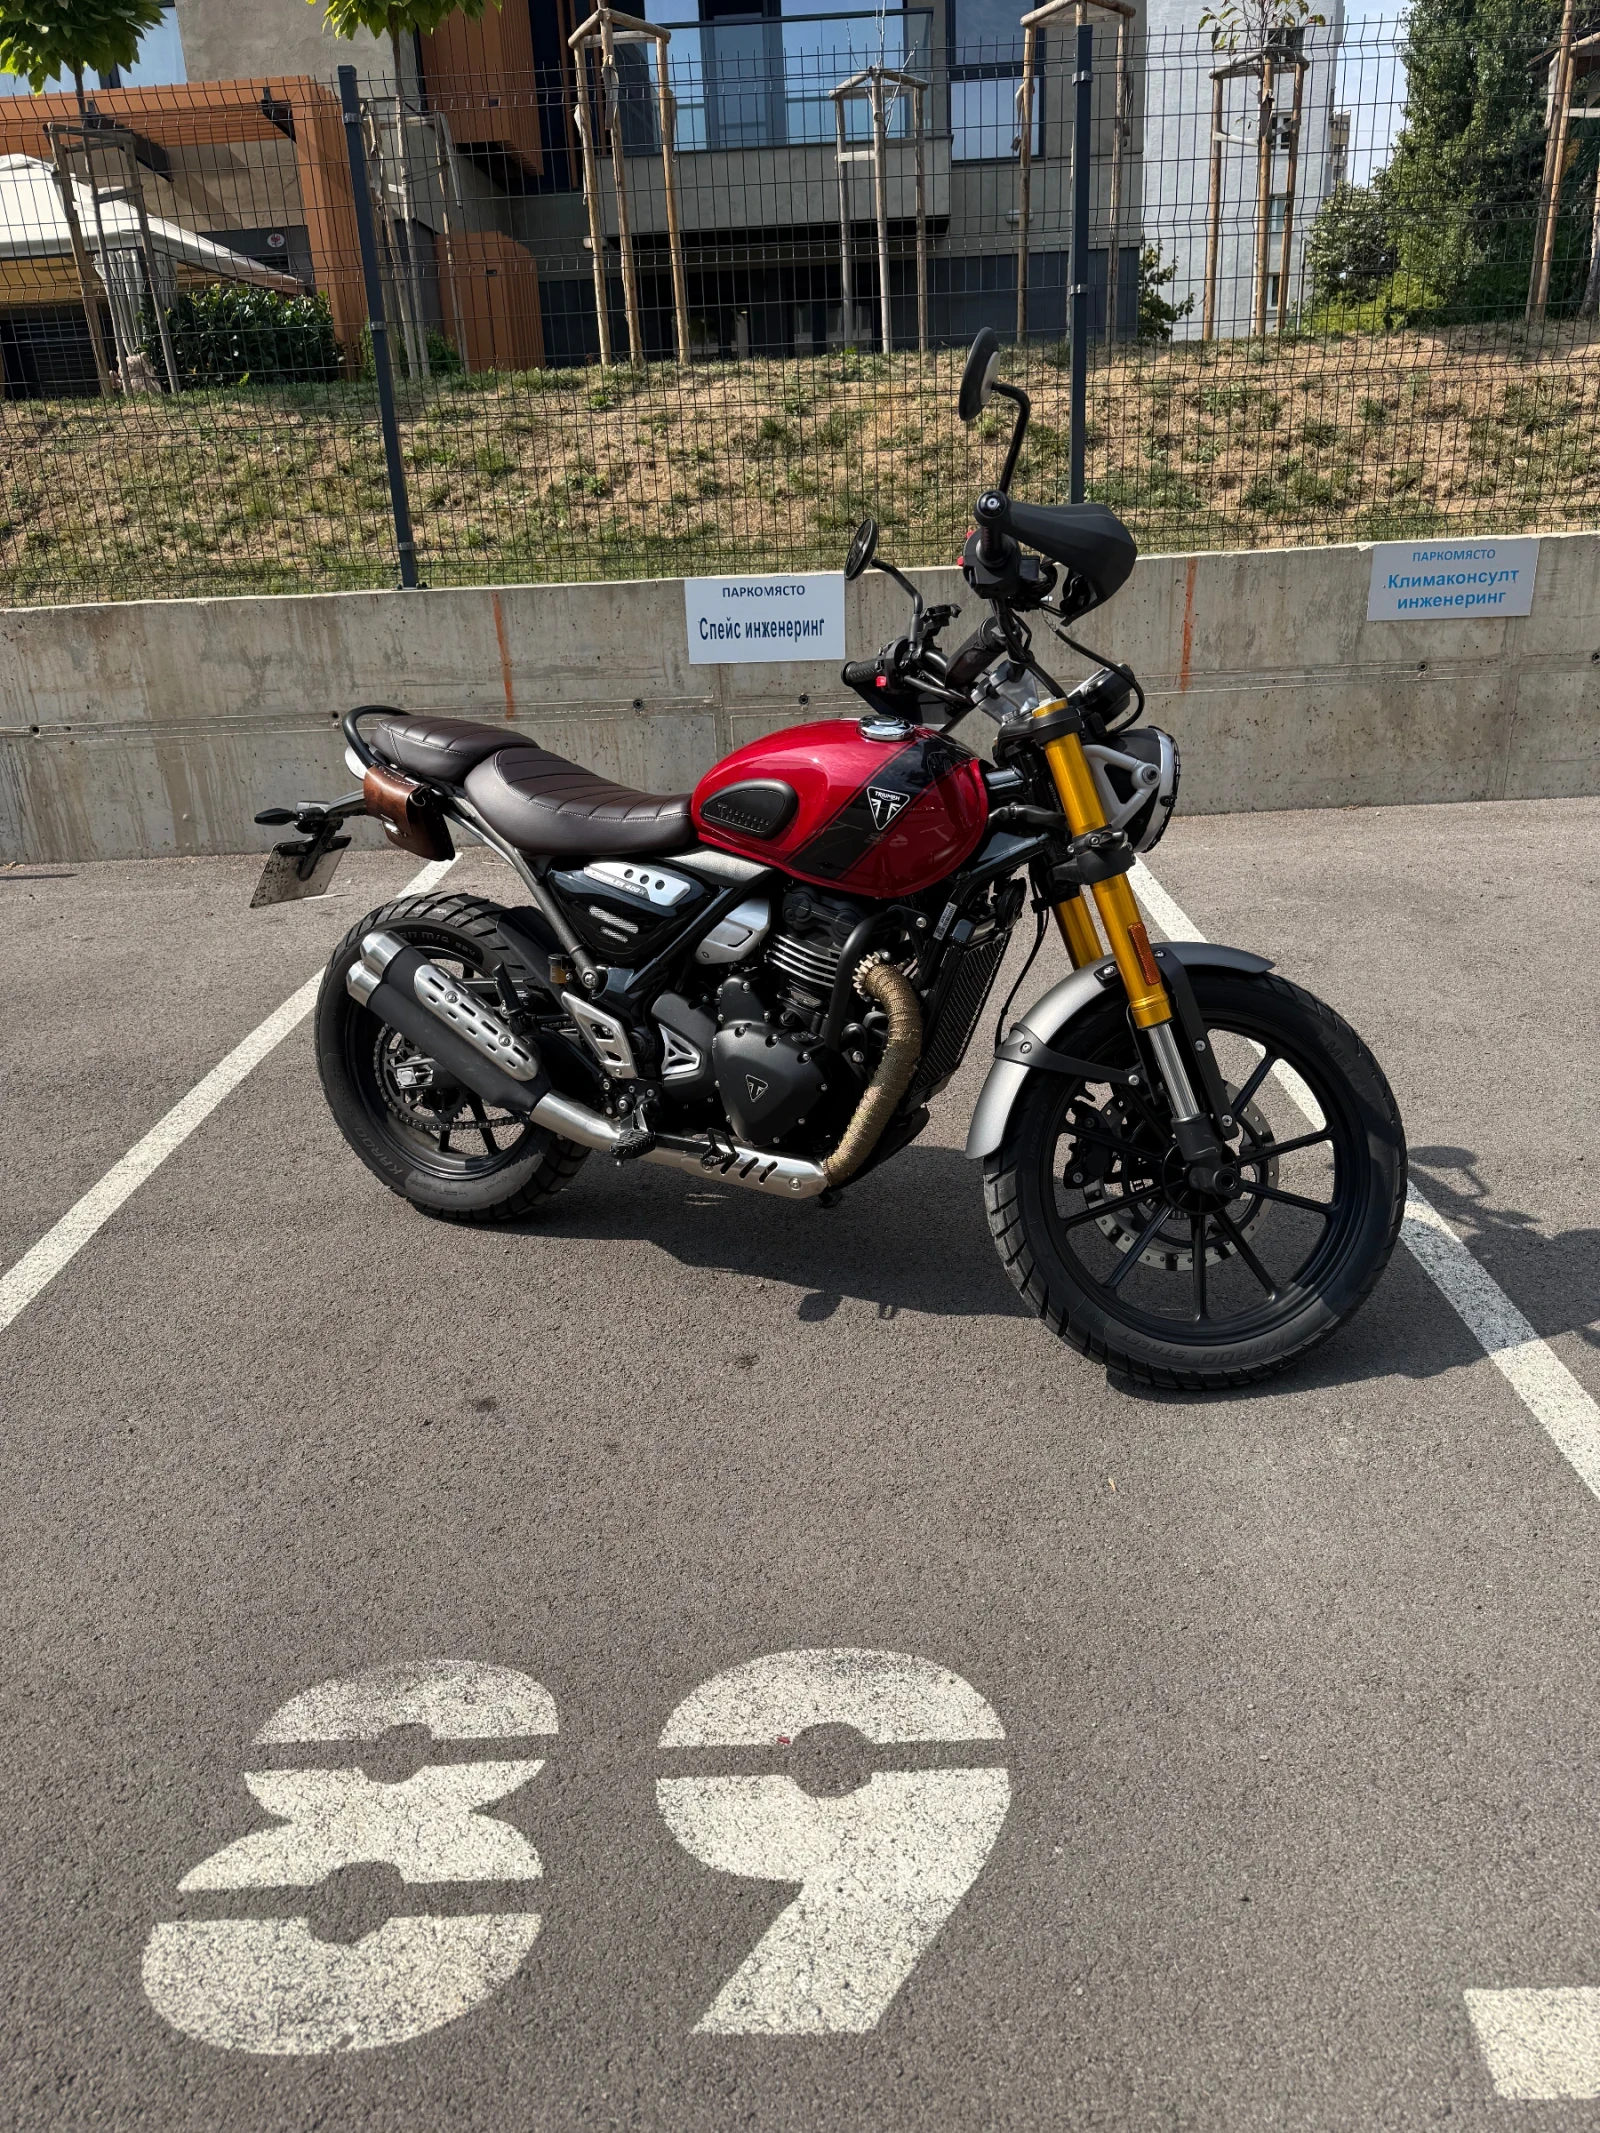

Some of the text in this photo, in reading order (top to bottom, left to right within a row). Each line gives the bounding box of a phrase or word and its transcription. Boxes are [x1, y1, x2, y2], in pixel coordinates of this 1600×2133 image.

[1413, 549, 1496, 562] ПАРКОМЯСТО
[1388, 570, 1519, 589] Климаконсулт
[722, 585, 806, 598] ПАРКОМЯСТО
[1397, 592, 1506, 609] инженеринг
[700, 616, 825, 642] Спейс инженеринг
[874, 790, 901, 802] TRIUMPH
[353, 1127, 403, 1175] KAROO
[141, 1647, 1011, 2056] 89
